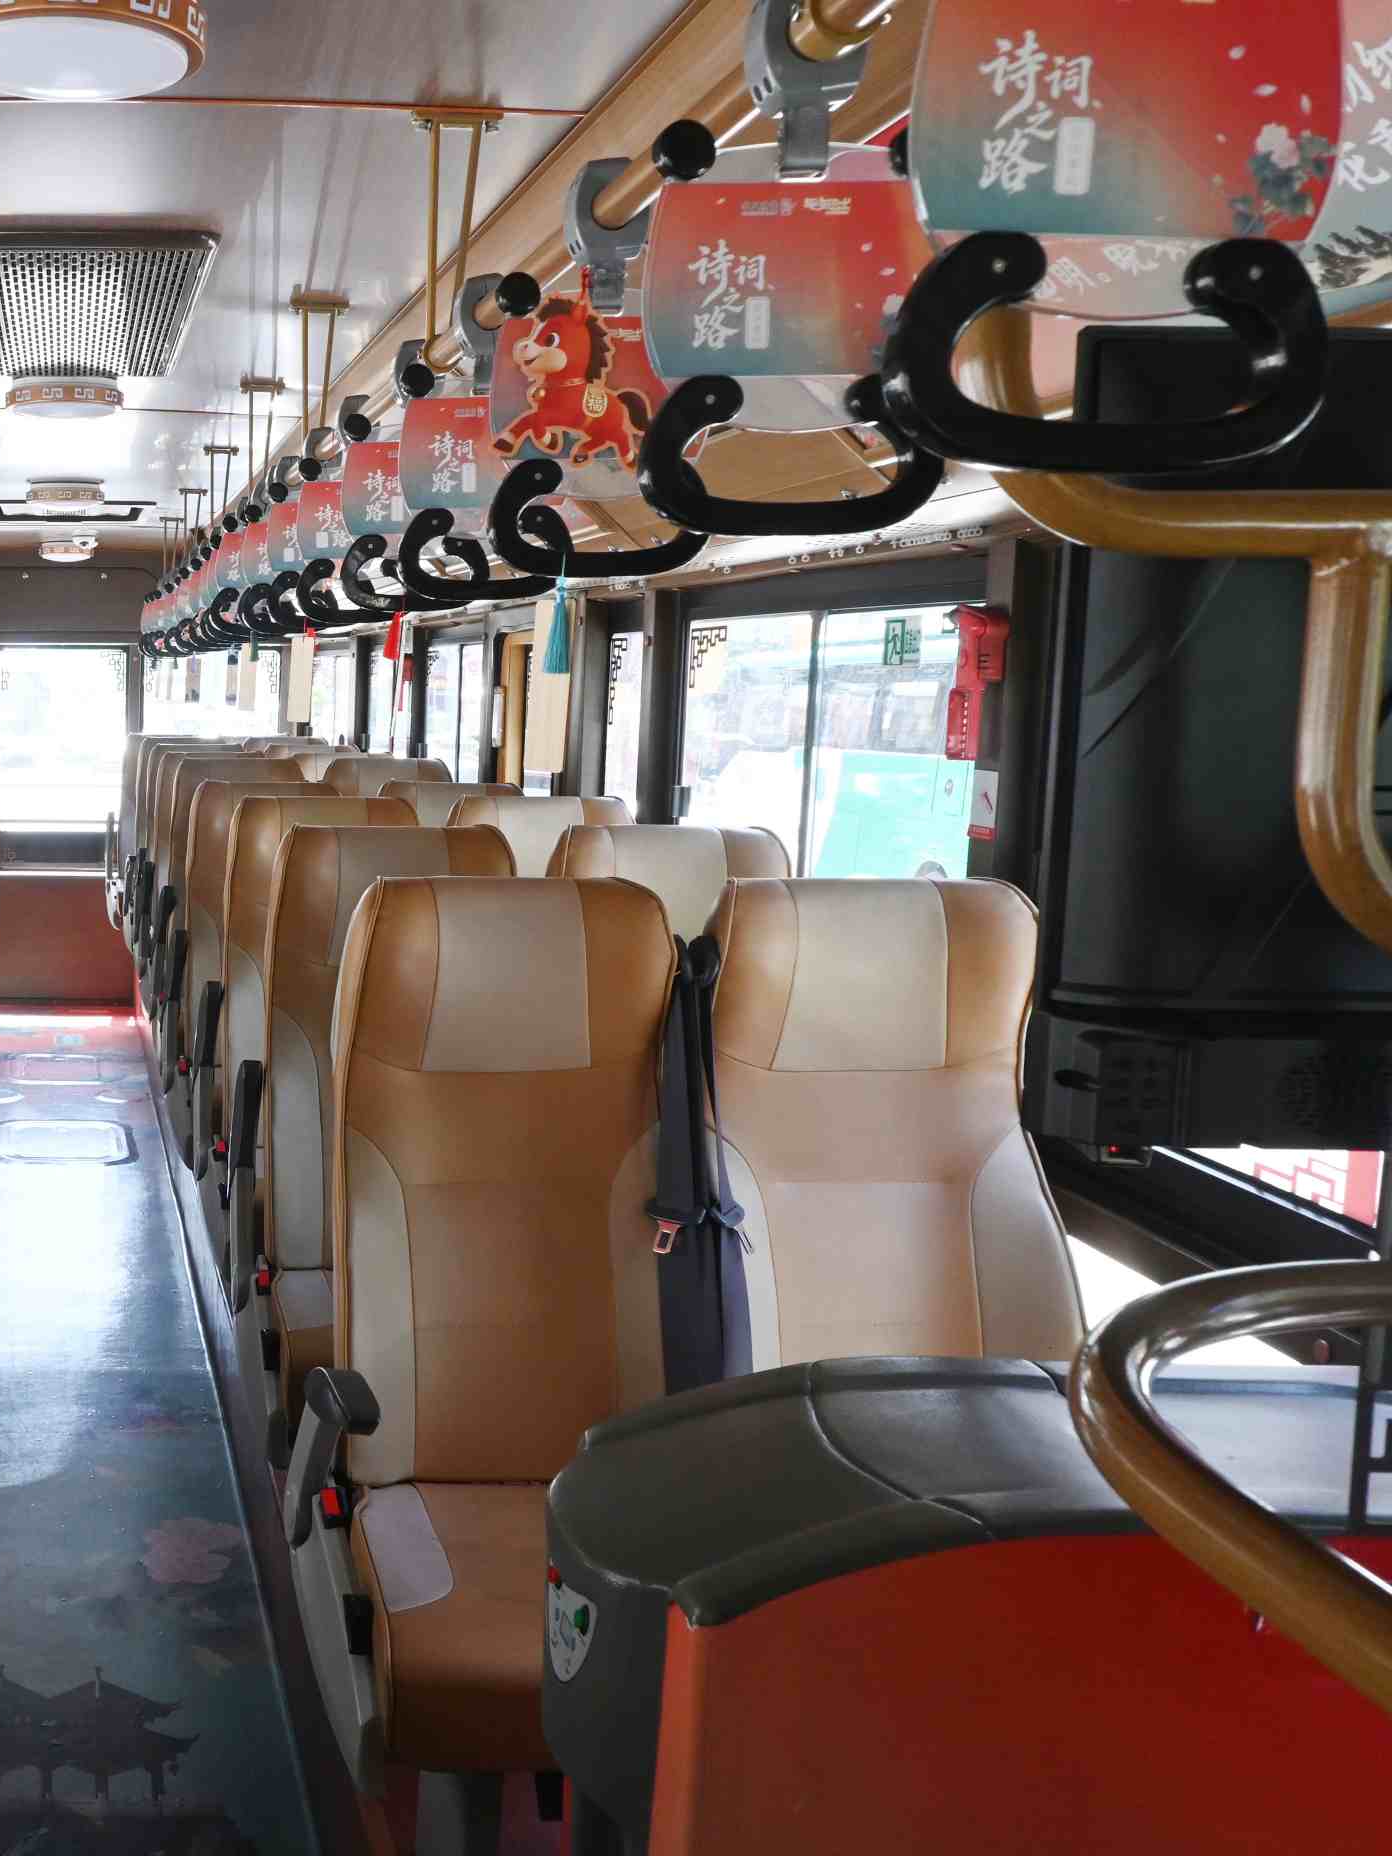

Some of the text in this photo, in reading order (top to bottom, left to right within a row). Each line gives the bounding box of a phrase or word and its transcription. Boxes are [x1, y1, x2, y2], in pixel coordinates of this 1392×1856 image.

[978, 29, 1095, 194] 诗词之路
[688, 239, 767, 350] 诗词之路
[428, 430, 475, 495] 诗词之路
